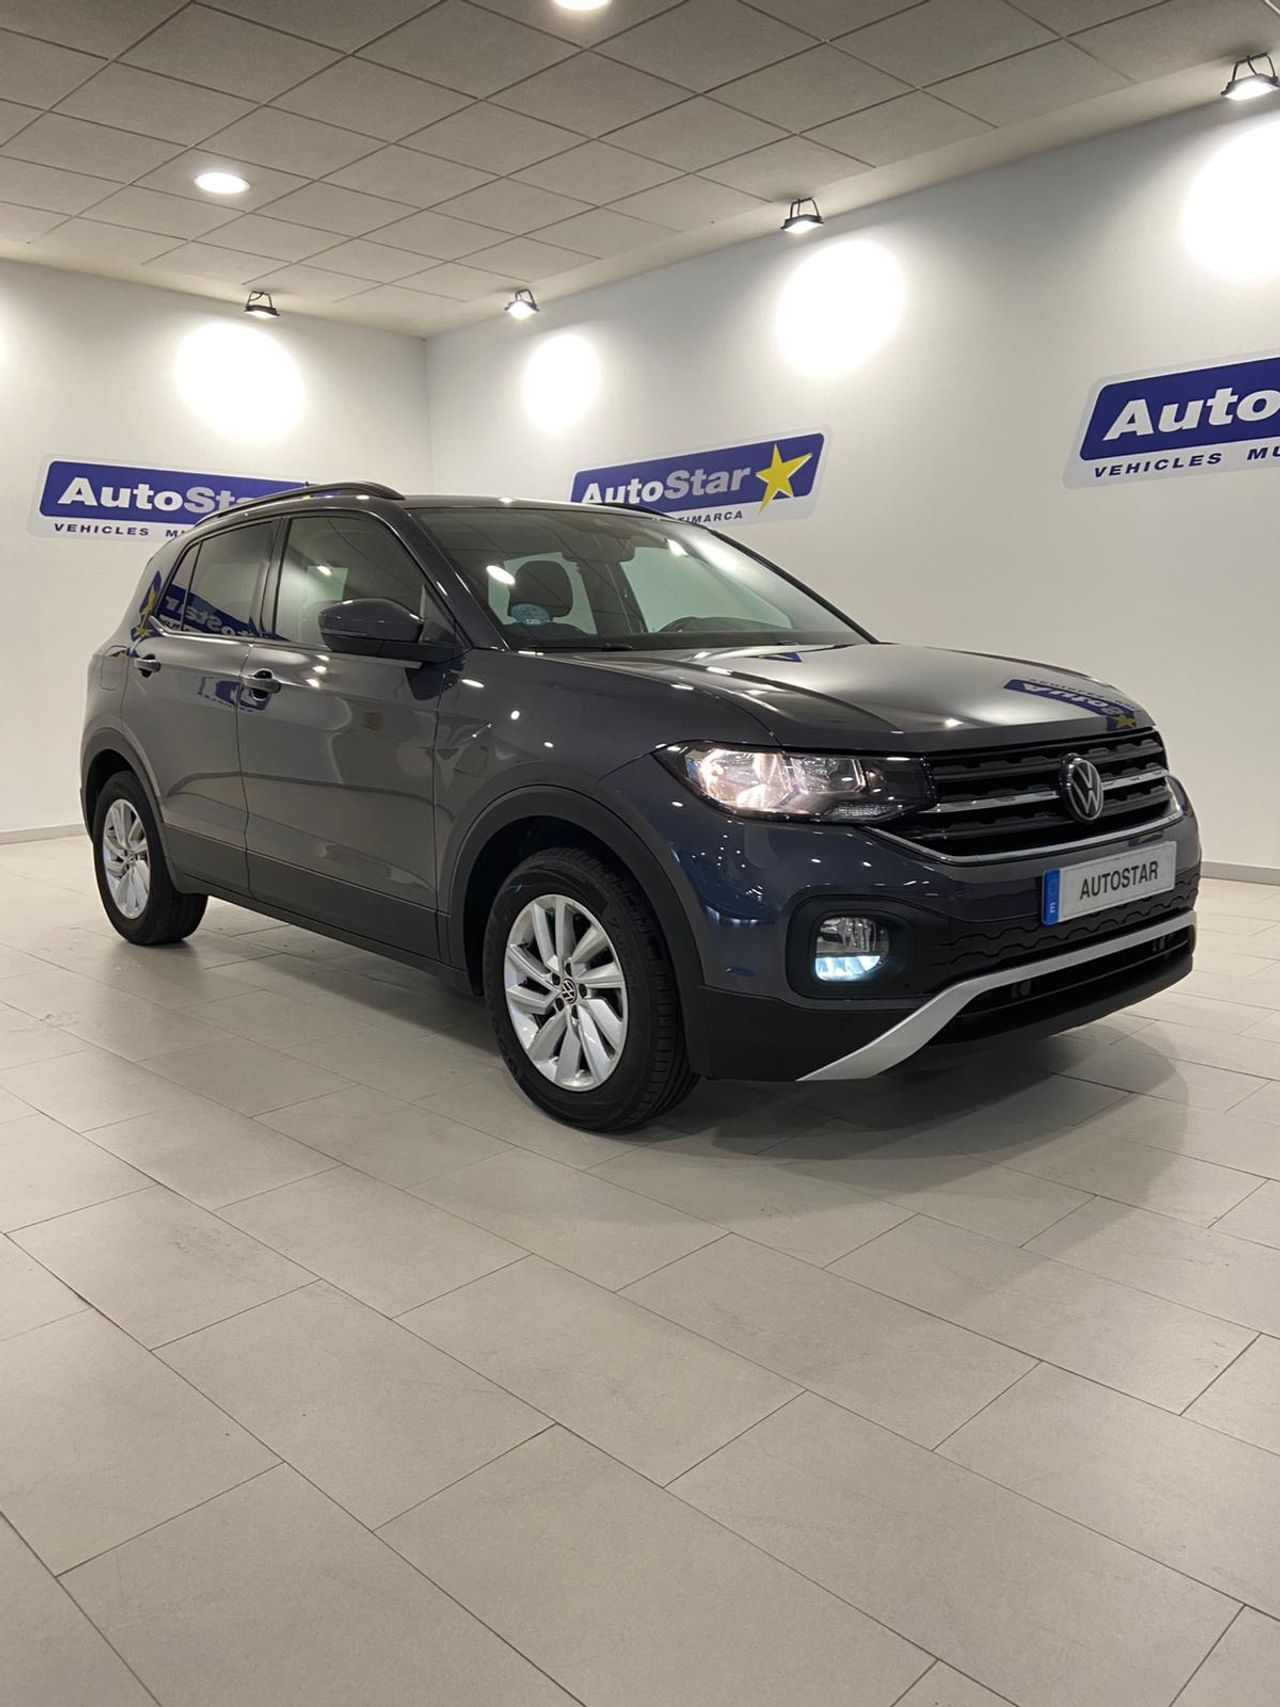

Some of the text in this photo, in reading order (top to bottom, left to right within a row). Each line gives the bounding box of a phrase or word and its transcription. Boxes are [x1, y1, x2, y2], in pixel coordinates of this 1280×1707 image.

[1102, 386, 1280, 442] Auto
[1094, 453, 1222, 478] VEHICLES
[581, 466, 750, 504] AutoStar
[54, 523, 150, 537] VEHICLES
[1079, 860, 1159, 900] AUTOSTAR
